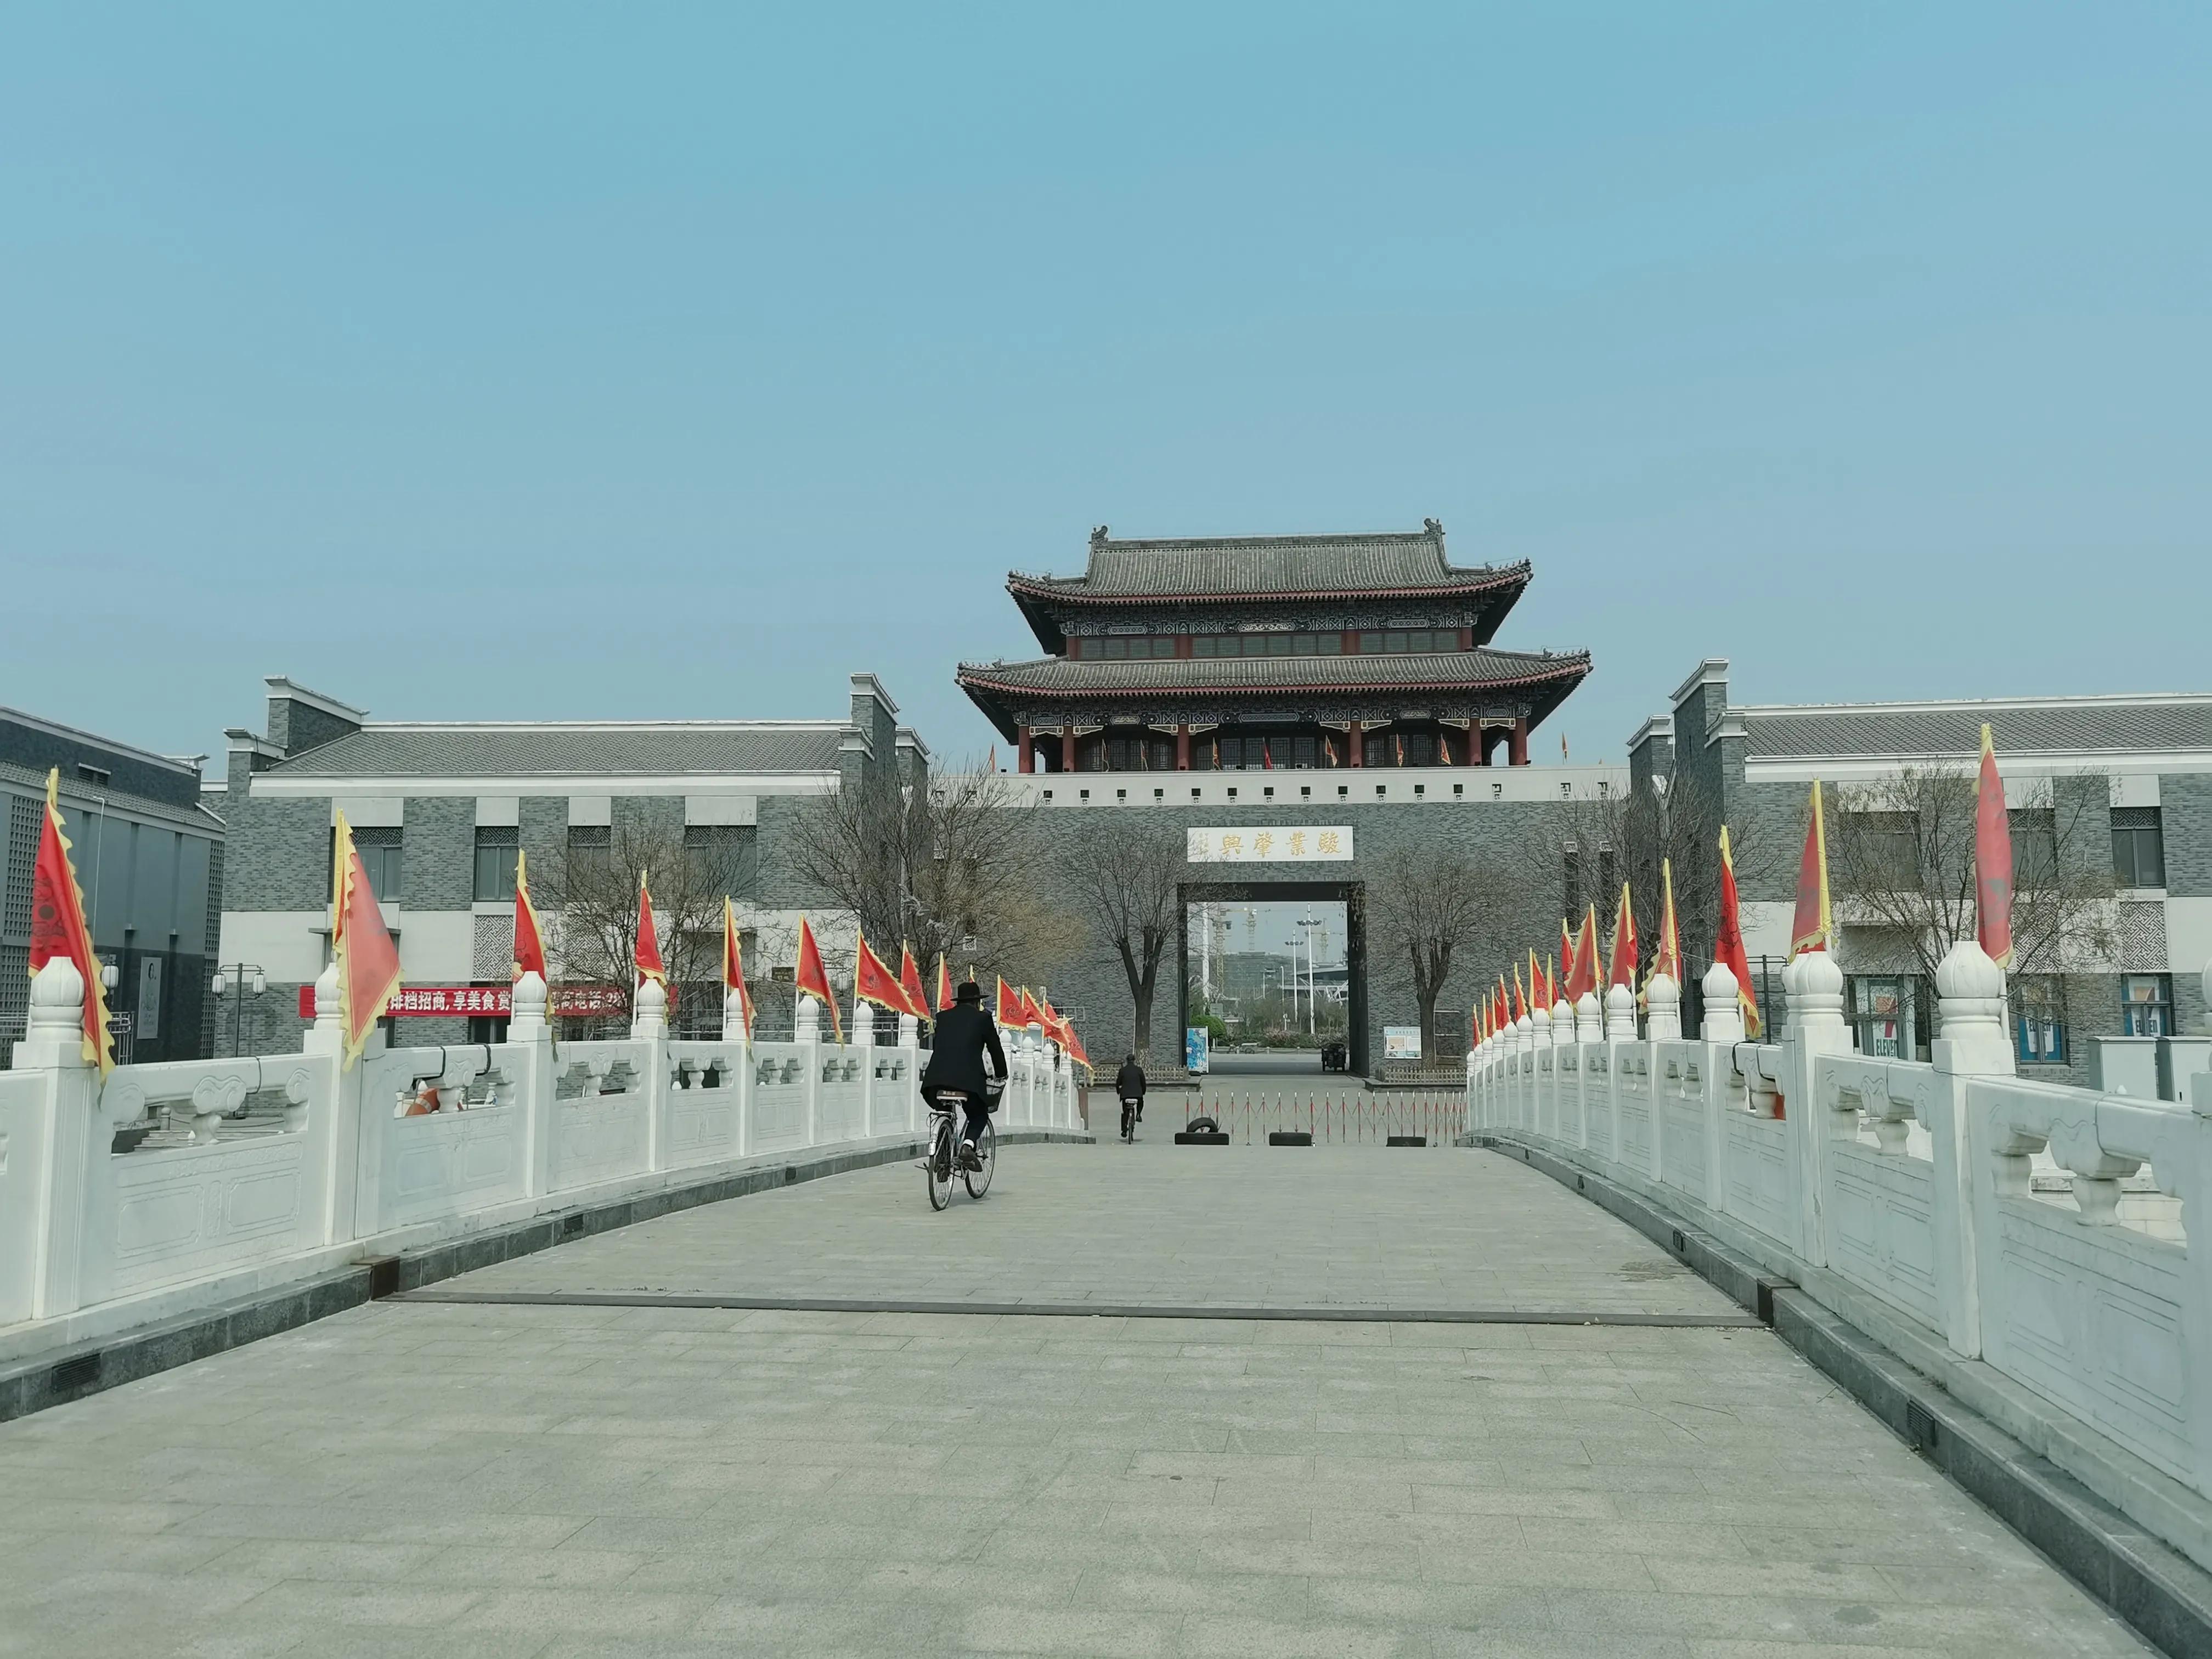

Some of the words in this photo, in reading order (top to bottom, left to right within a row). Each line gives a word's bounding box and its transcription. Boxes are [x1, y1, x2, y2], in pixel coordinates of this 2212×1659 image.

[386, 990, 511, 1011] 排档招商,享美食赏
